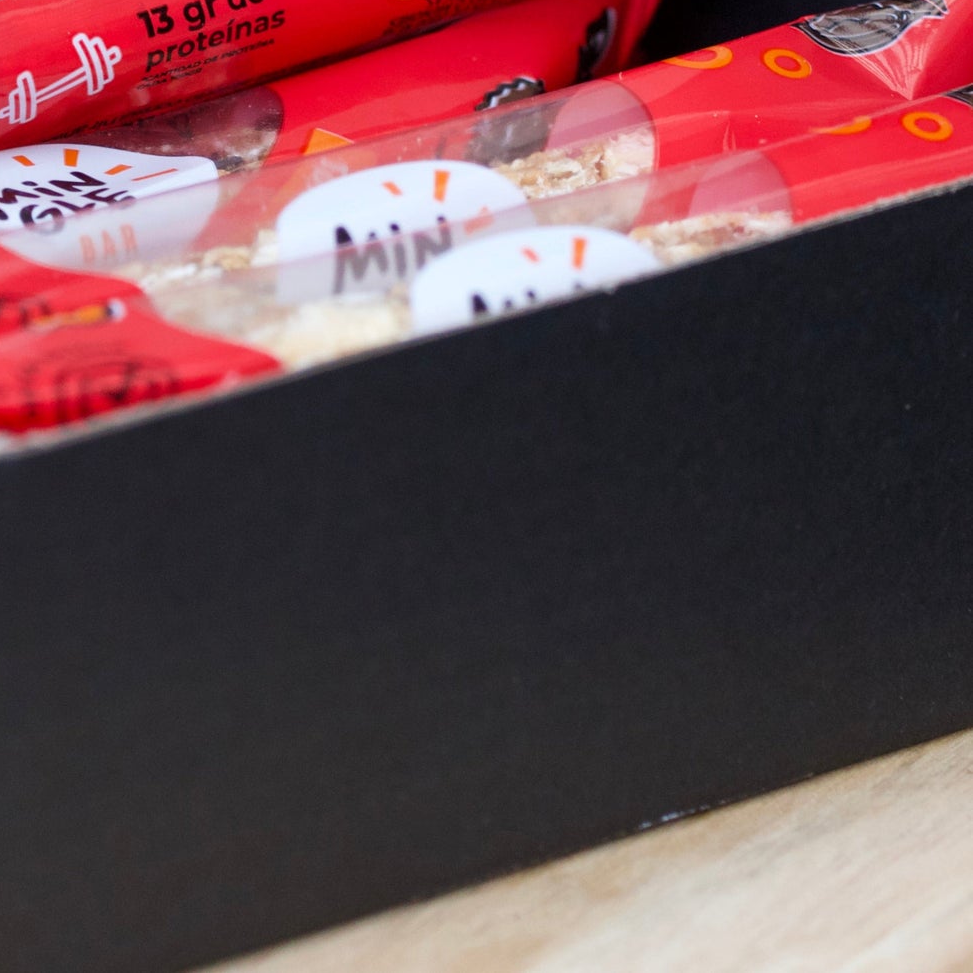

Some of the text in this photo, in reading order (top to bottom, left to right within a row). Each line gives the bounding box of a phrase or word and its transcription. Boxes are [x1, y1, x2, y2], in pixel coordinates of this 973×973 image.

[136, 4, 175, 38] 13
[145, 9, 286, 73] proteínas
[19, 187, 136, 235] GLE
